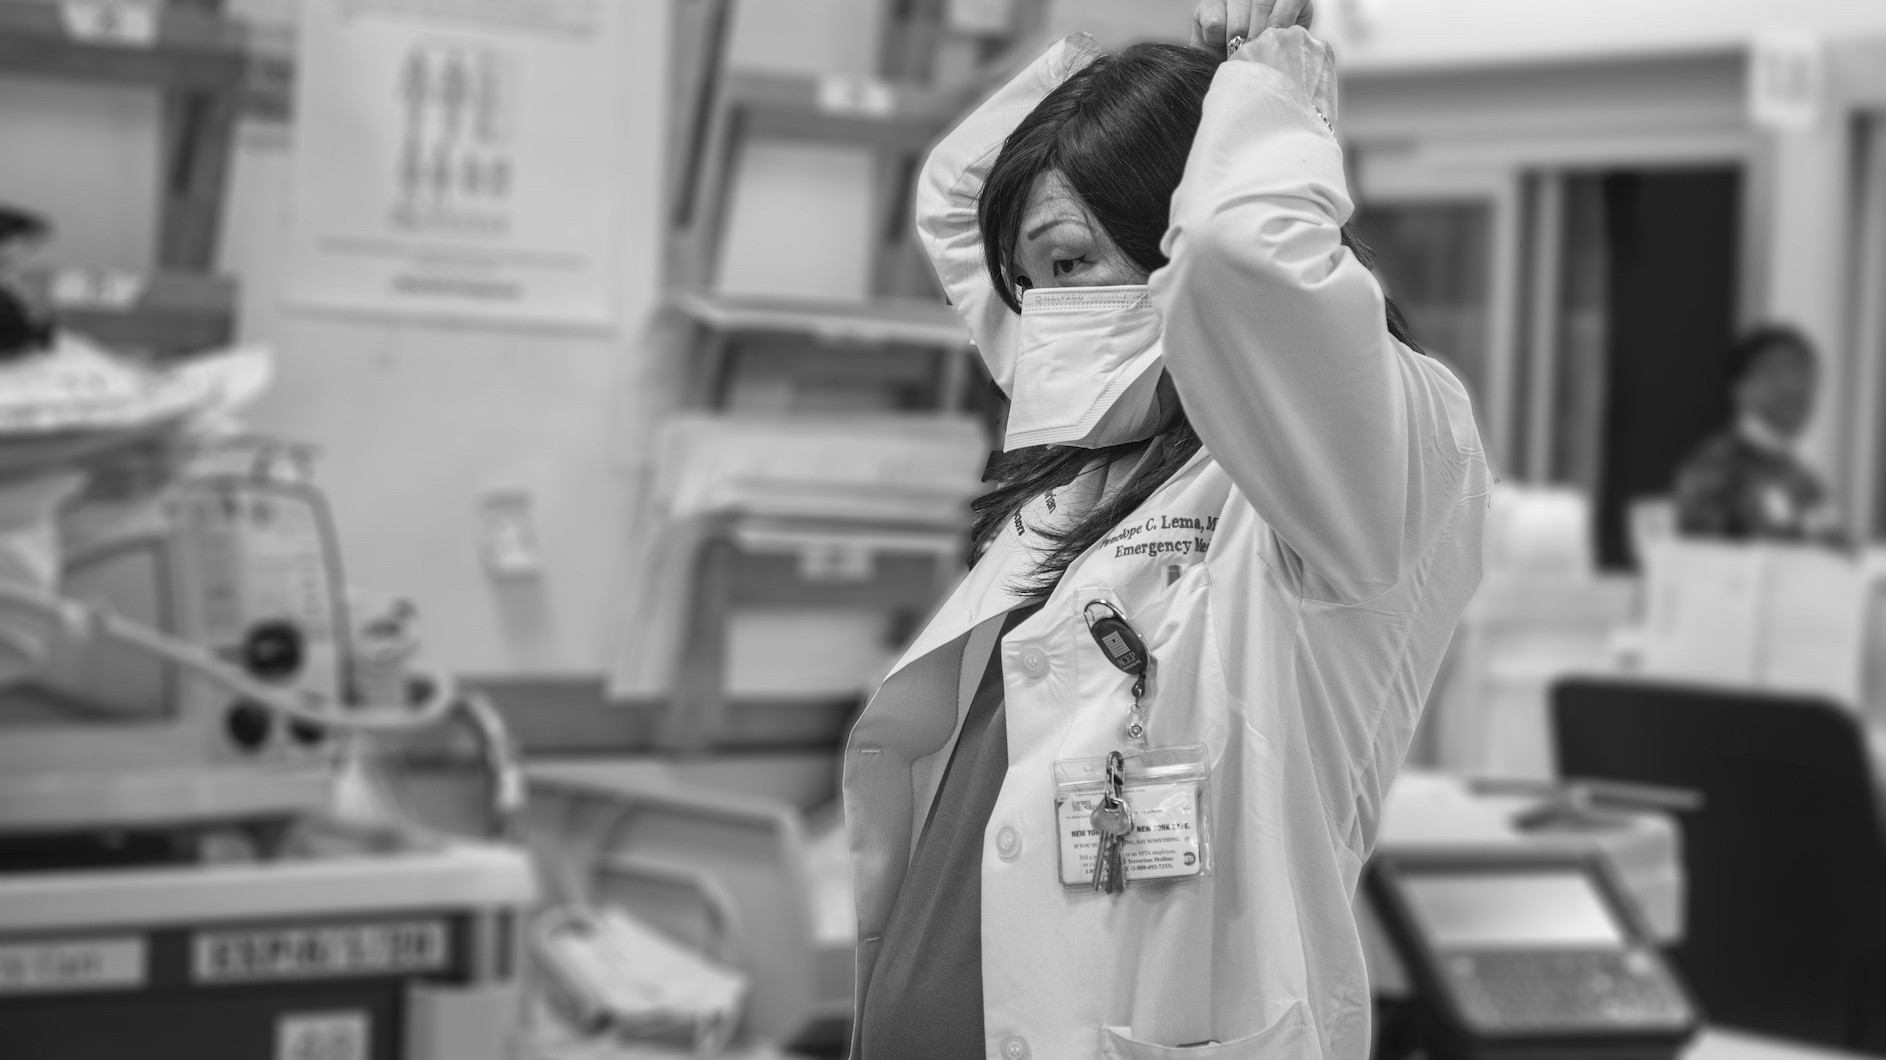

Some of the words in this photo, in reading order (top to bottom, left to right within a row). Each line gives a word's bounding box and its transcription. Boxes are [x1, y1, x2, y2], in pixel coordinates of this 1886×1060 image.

[1145, 518, 1157, 531] C.
[1161, 515, 1205, 533] Lema,
[1206, 516, 1219, 531] M
[1115, 541, 1192, 558] Emergency
[1071, 830, 1086, 838] NEW
[1137, 825, 1151, 833] NEW
